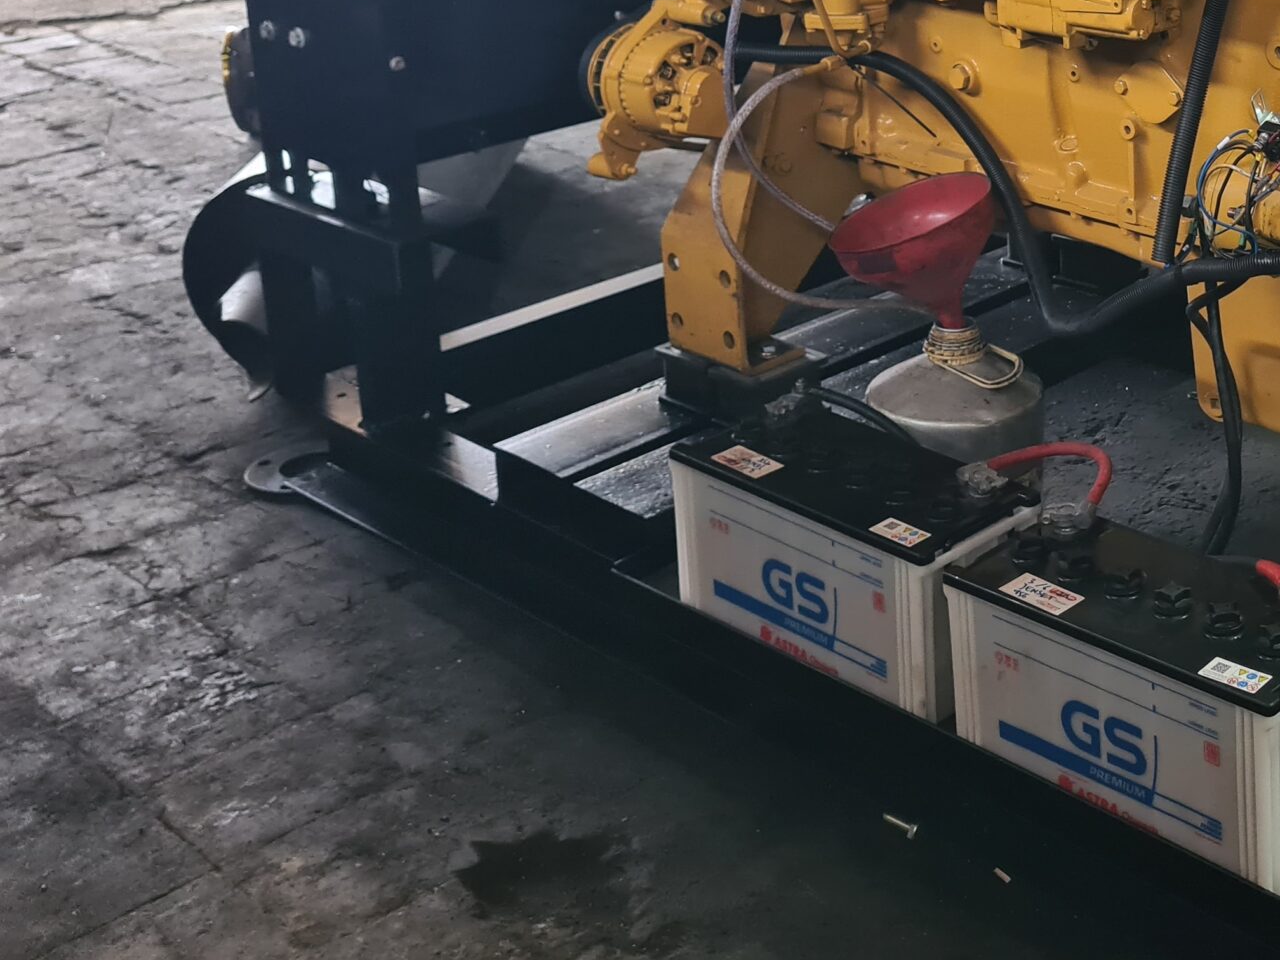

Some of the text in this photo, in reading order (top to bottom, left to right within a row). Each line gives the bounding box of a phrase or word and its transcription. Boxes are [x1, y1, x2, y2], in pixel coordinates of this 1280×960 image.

[762, 558, 830, 624] GS
[1061, 700, 1148, 776] GS
[1089, 766, 1146, 798] PREMIUM
